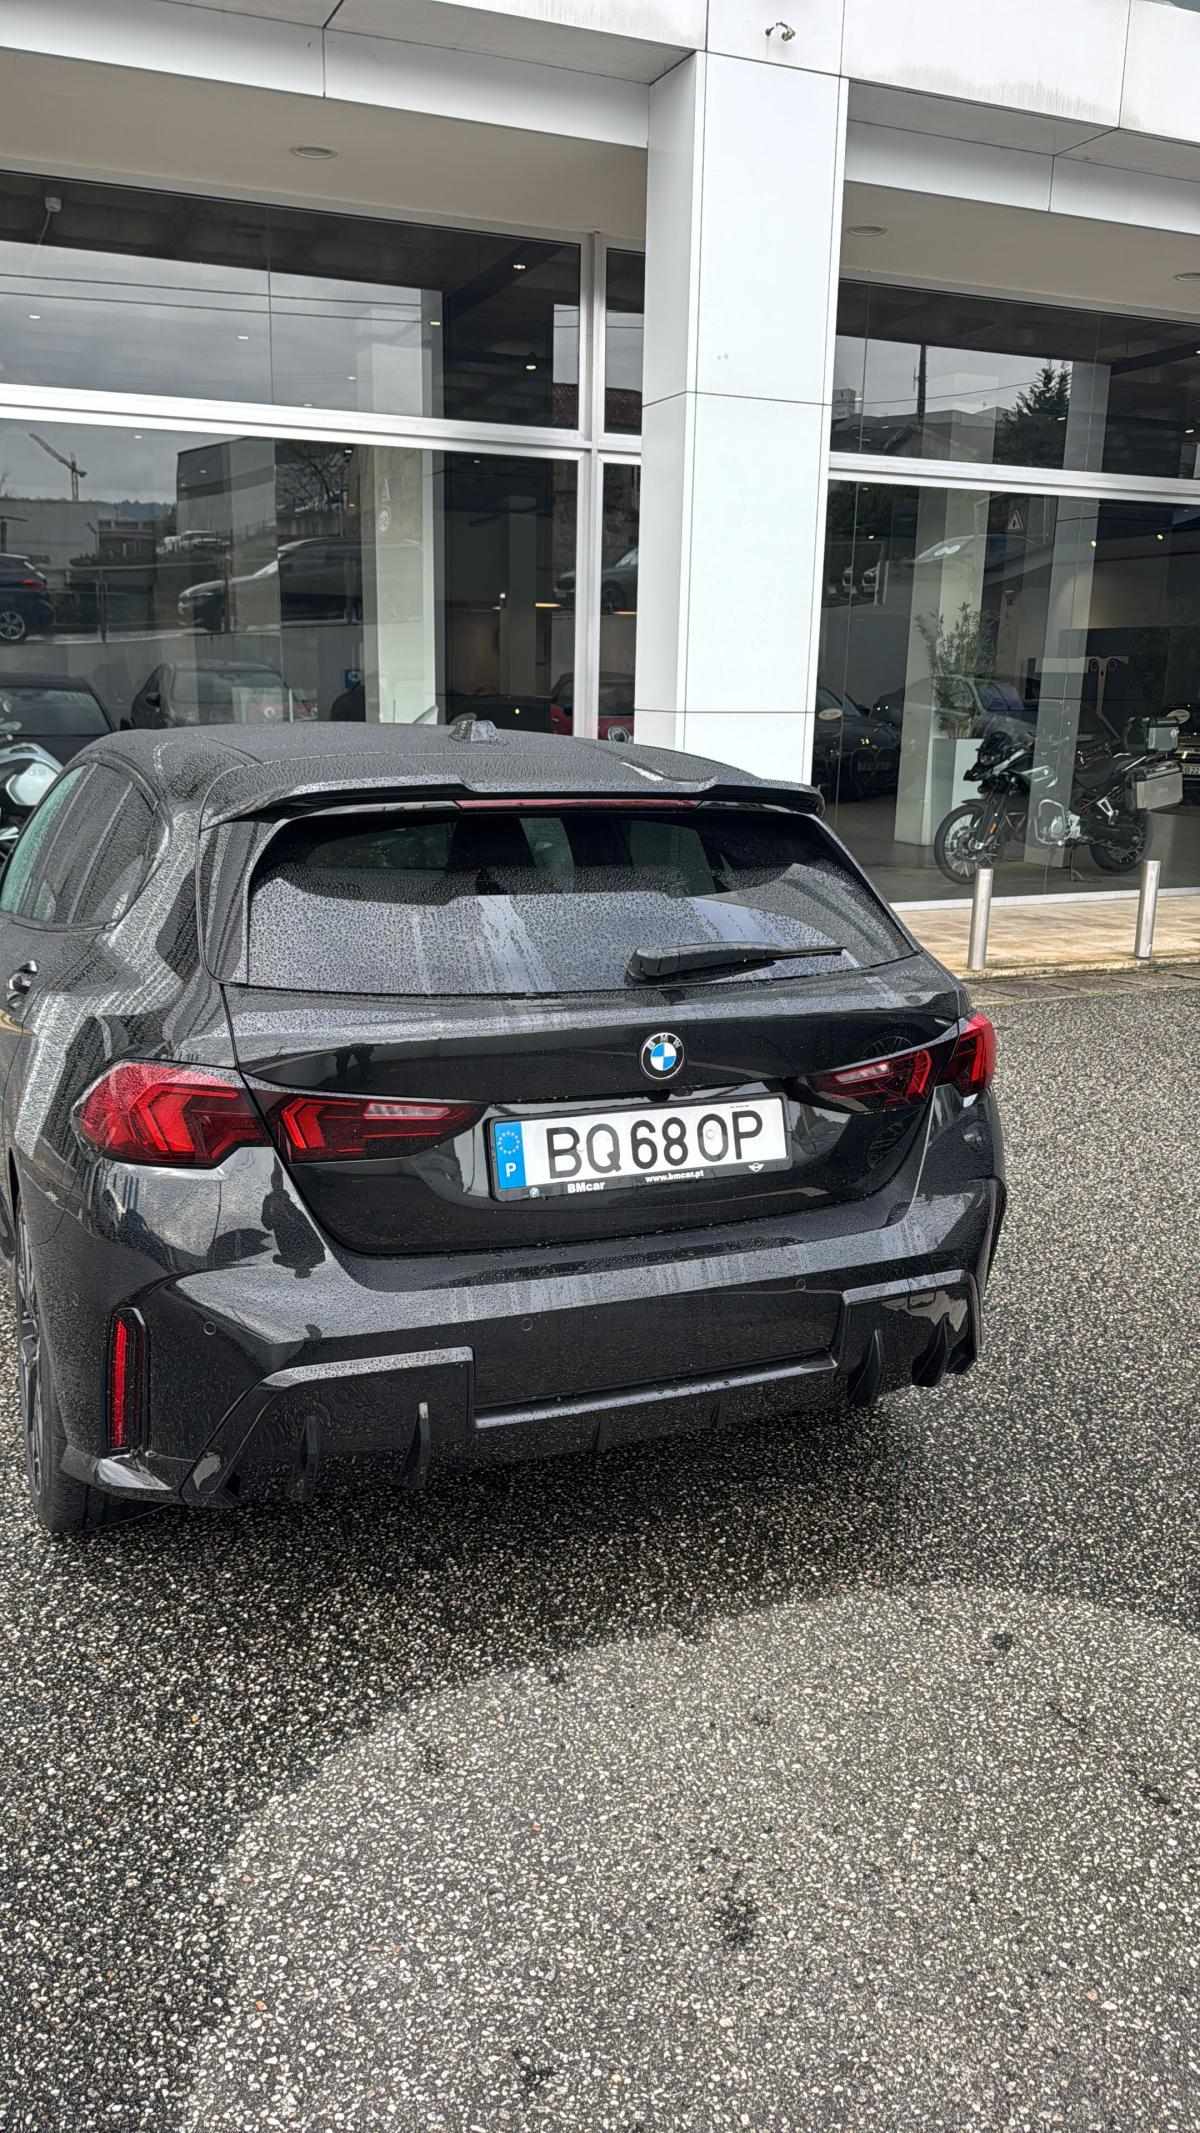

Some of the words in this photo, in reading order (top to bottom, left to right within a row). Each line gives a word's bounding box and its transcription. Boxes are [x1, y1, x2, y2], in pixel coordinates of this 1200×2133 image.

[546, 1123, 622, 1179] BQ
[630, 1116, 688, 1169] 68
[697, 1110, 763, 1162] OP
[505, 1162, 517, 1177] P
[645, 1169, 704, 1183] www.bmcar.pt
[567, 1181, 606, 1194] BMcar
